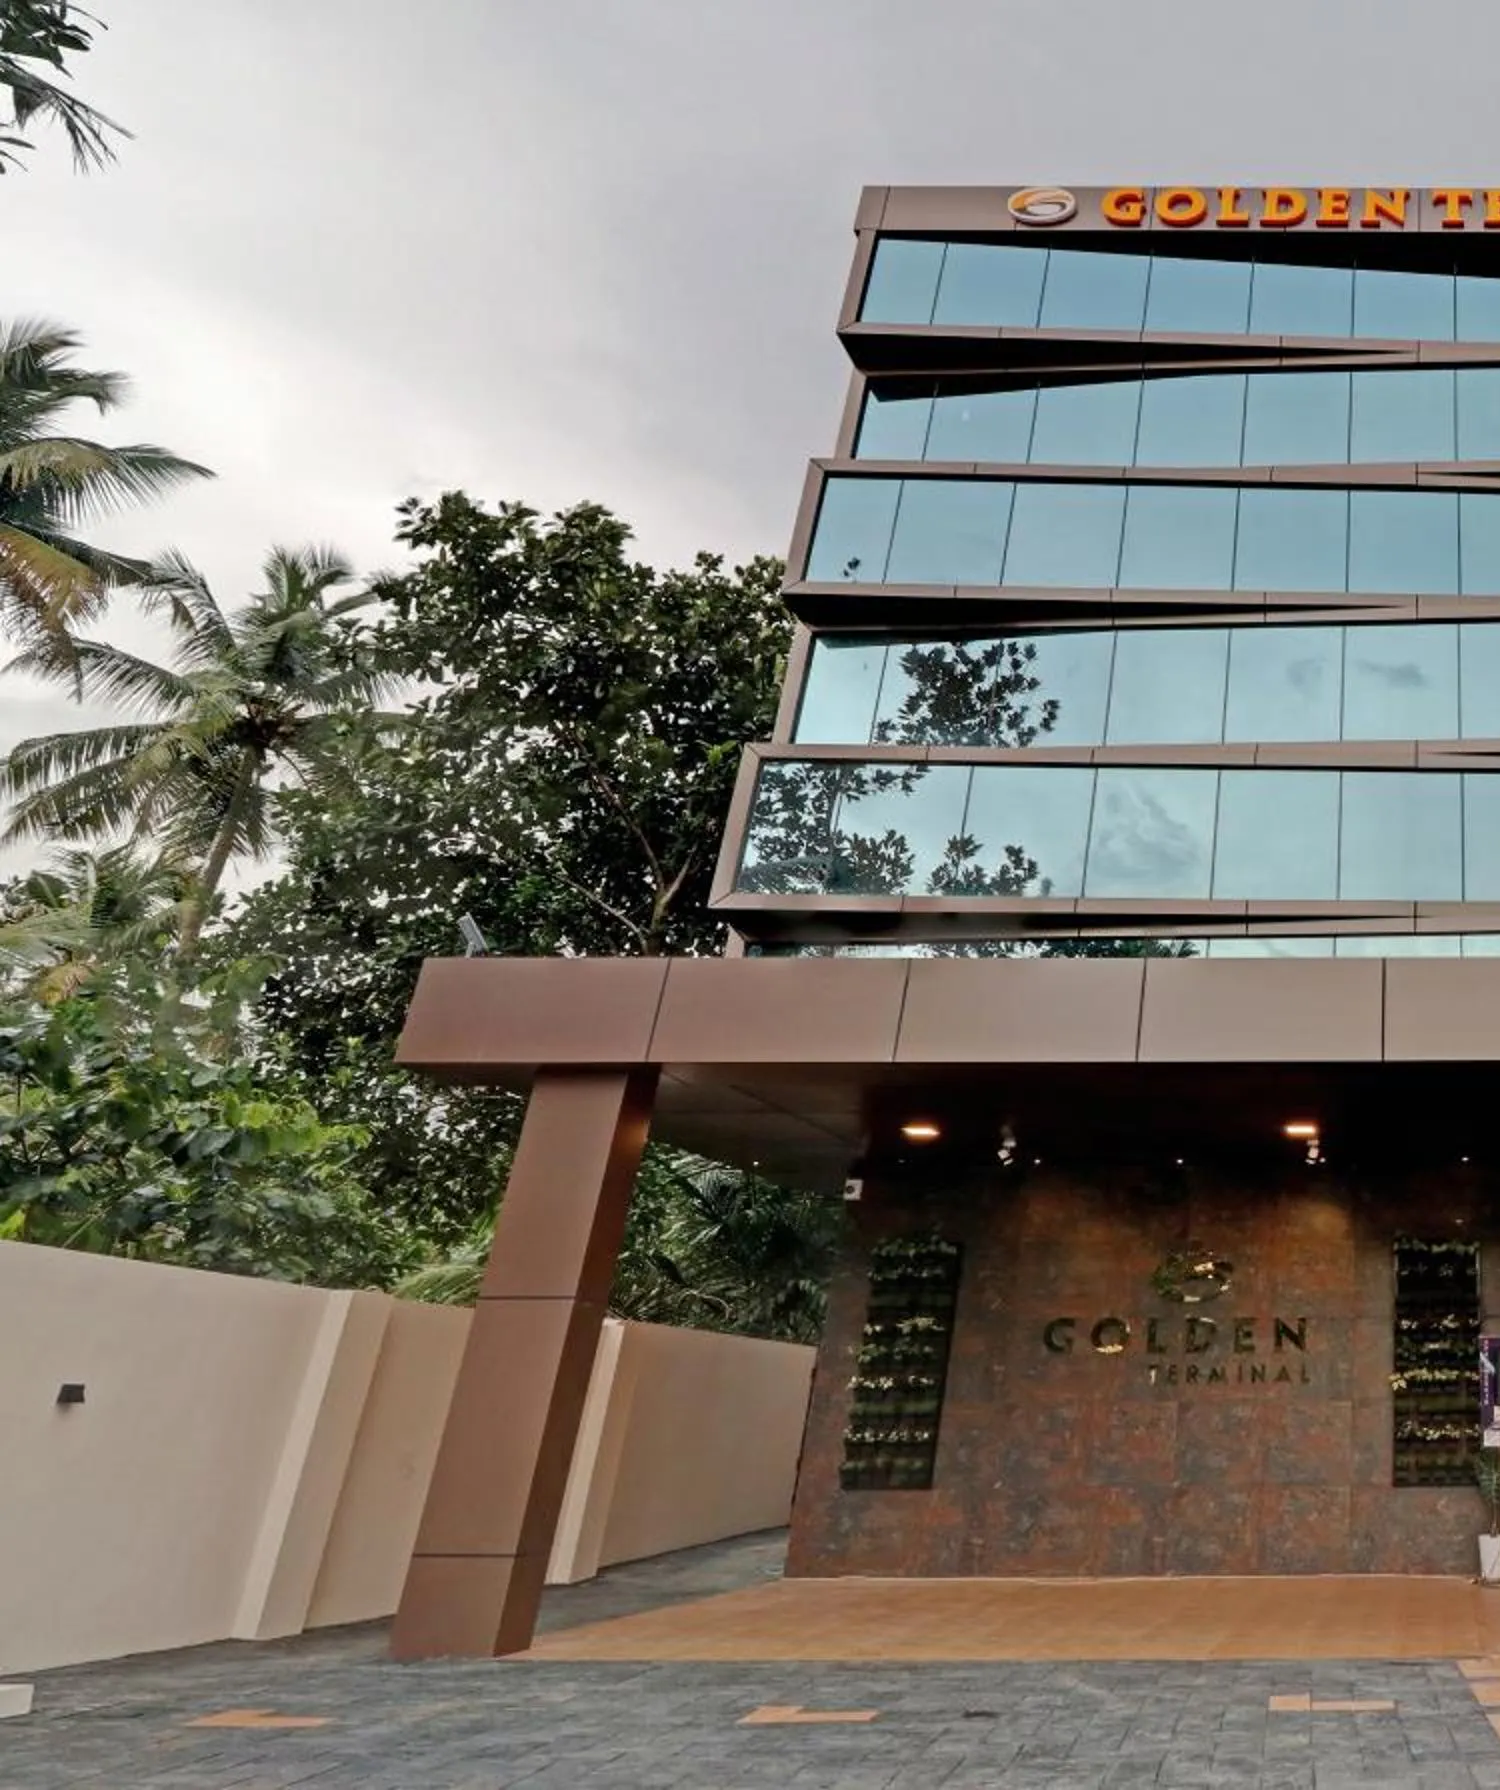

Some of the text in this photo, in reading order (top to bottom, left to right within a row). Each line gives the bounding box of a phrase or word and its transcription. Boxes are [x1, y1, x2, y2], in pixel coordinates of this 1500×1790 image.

[1101, 188, 1410, 228] GOLDEN
[1043, 1316, 1306, 1353] GOLDEN
[1148, 1365, 1310, 1385] TERMINAL
